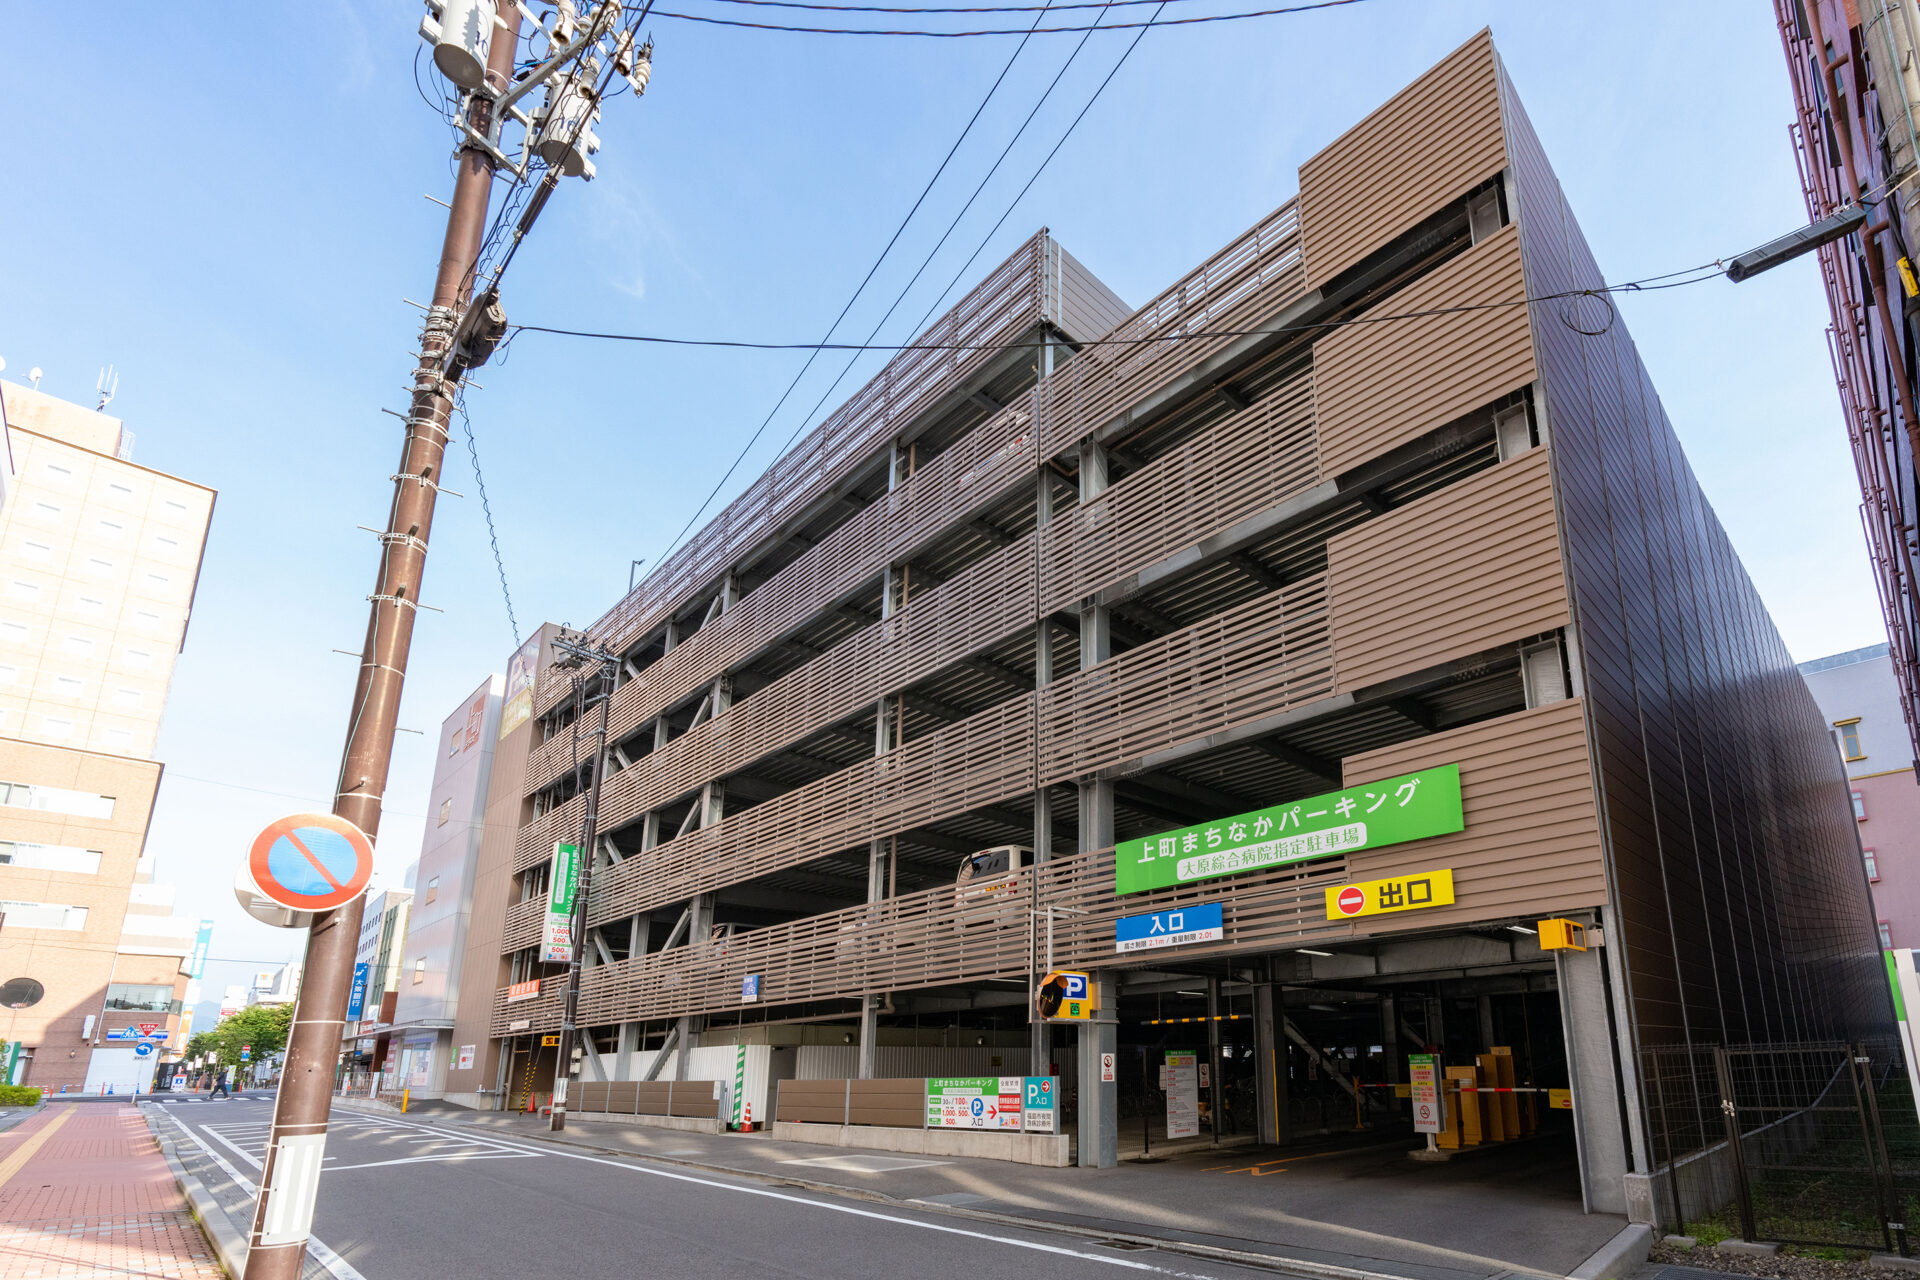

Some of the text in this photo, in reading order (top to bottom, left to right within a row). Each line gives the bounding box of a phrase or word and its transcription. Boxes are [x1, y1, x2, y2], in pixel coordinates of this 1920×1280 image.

[1137, 778, 1420, 864] 上町まちなかパーキング
[1182, 827, 1360, 877] 大原綜合病院指定駐車場
[1379, 878, 1432, 909] 出口
[1149, 912, 1184, 935] 入口
[1148, 938, 1165, 947] 2.1m
[1198, 931, 1212, 940] 2.0t
[352, 979, 364, 1007] 大東銀行
[1066, 977, 1083, 997] P
[1028, 1084, 1038, 1105] P
[1036, 1097, 1047, 1105] 入口
[973, 1100, 981, 1114] P
[971, 1117, 983, 1127] 入口
